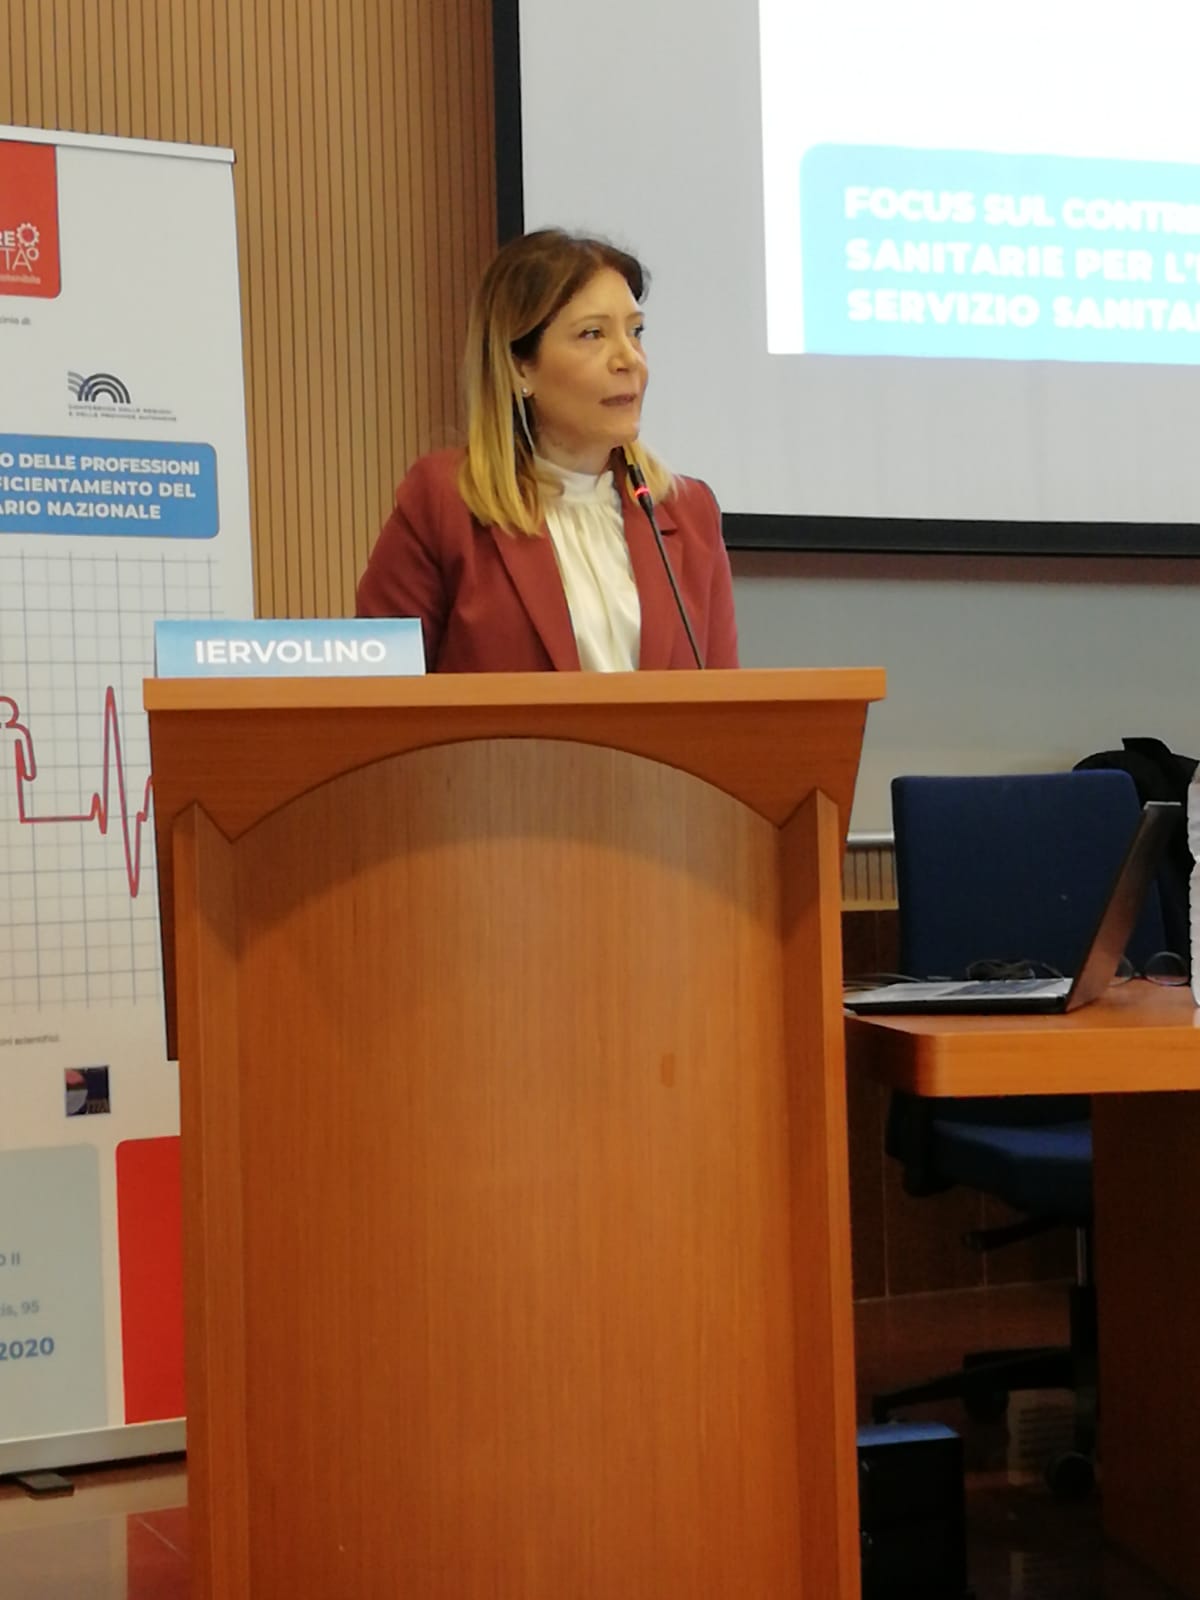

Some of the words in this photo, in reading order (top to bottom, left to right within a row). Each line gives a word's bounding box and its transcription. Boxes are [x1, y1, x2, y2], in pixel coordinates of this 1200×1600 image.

[844, 187, 976, 223] FOCUS
[984, 194, 1056, 227] SUL
[846, 238, 1064, 279] SANITARIE
[1075, 248, 1153, 282] PER
[847, 288, 1040, 327] SERVIZIO
[0, 452, 14, 468] O
[19, 453, 76, 471] DELLE
[81, 456, 200, 476] PROFESSIONI
[0, 476, 153, 496] ICIENTAMENTO
[159, 481, 196, 498] DEL
[47, 501, 161, 519] NAZIONALE
[195, 639, 387, 665] IERVOLINO
[21, 1300, 40, 1315] 95
